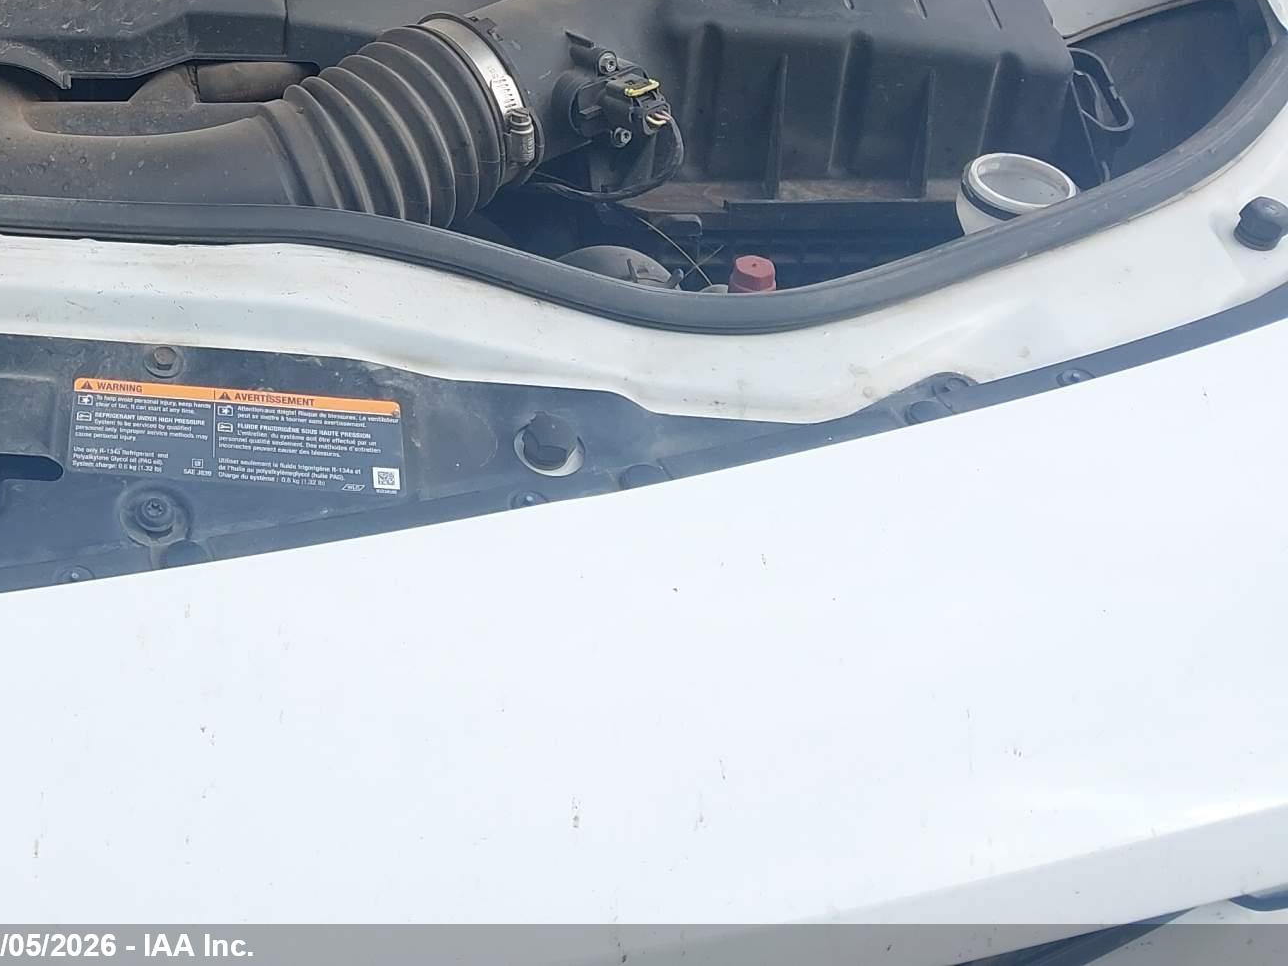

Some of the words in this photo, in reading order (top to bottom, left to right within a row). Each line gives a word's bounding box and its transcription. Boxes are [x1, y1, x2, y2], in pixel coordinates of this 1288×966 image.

[96, 381, 143, 393] WARNING
[234, 393, 315, 407] AVERTISSEMENT
[94, 412, 136, 420] REFRIGERANT
[174, 417, 205, 426] PRESSURE
[237, 422, 259, 430] FLUIDE
[319, 429, 339, 437] HAUTE
[340, 431, 371, 439] PRESSION
